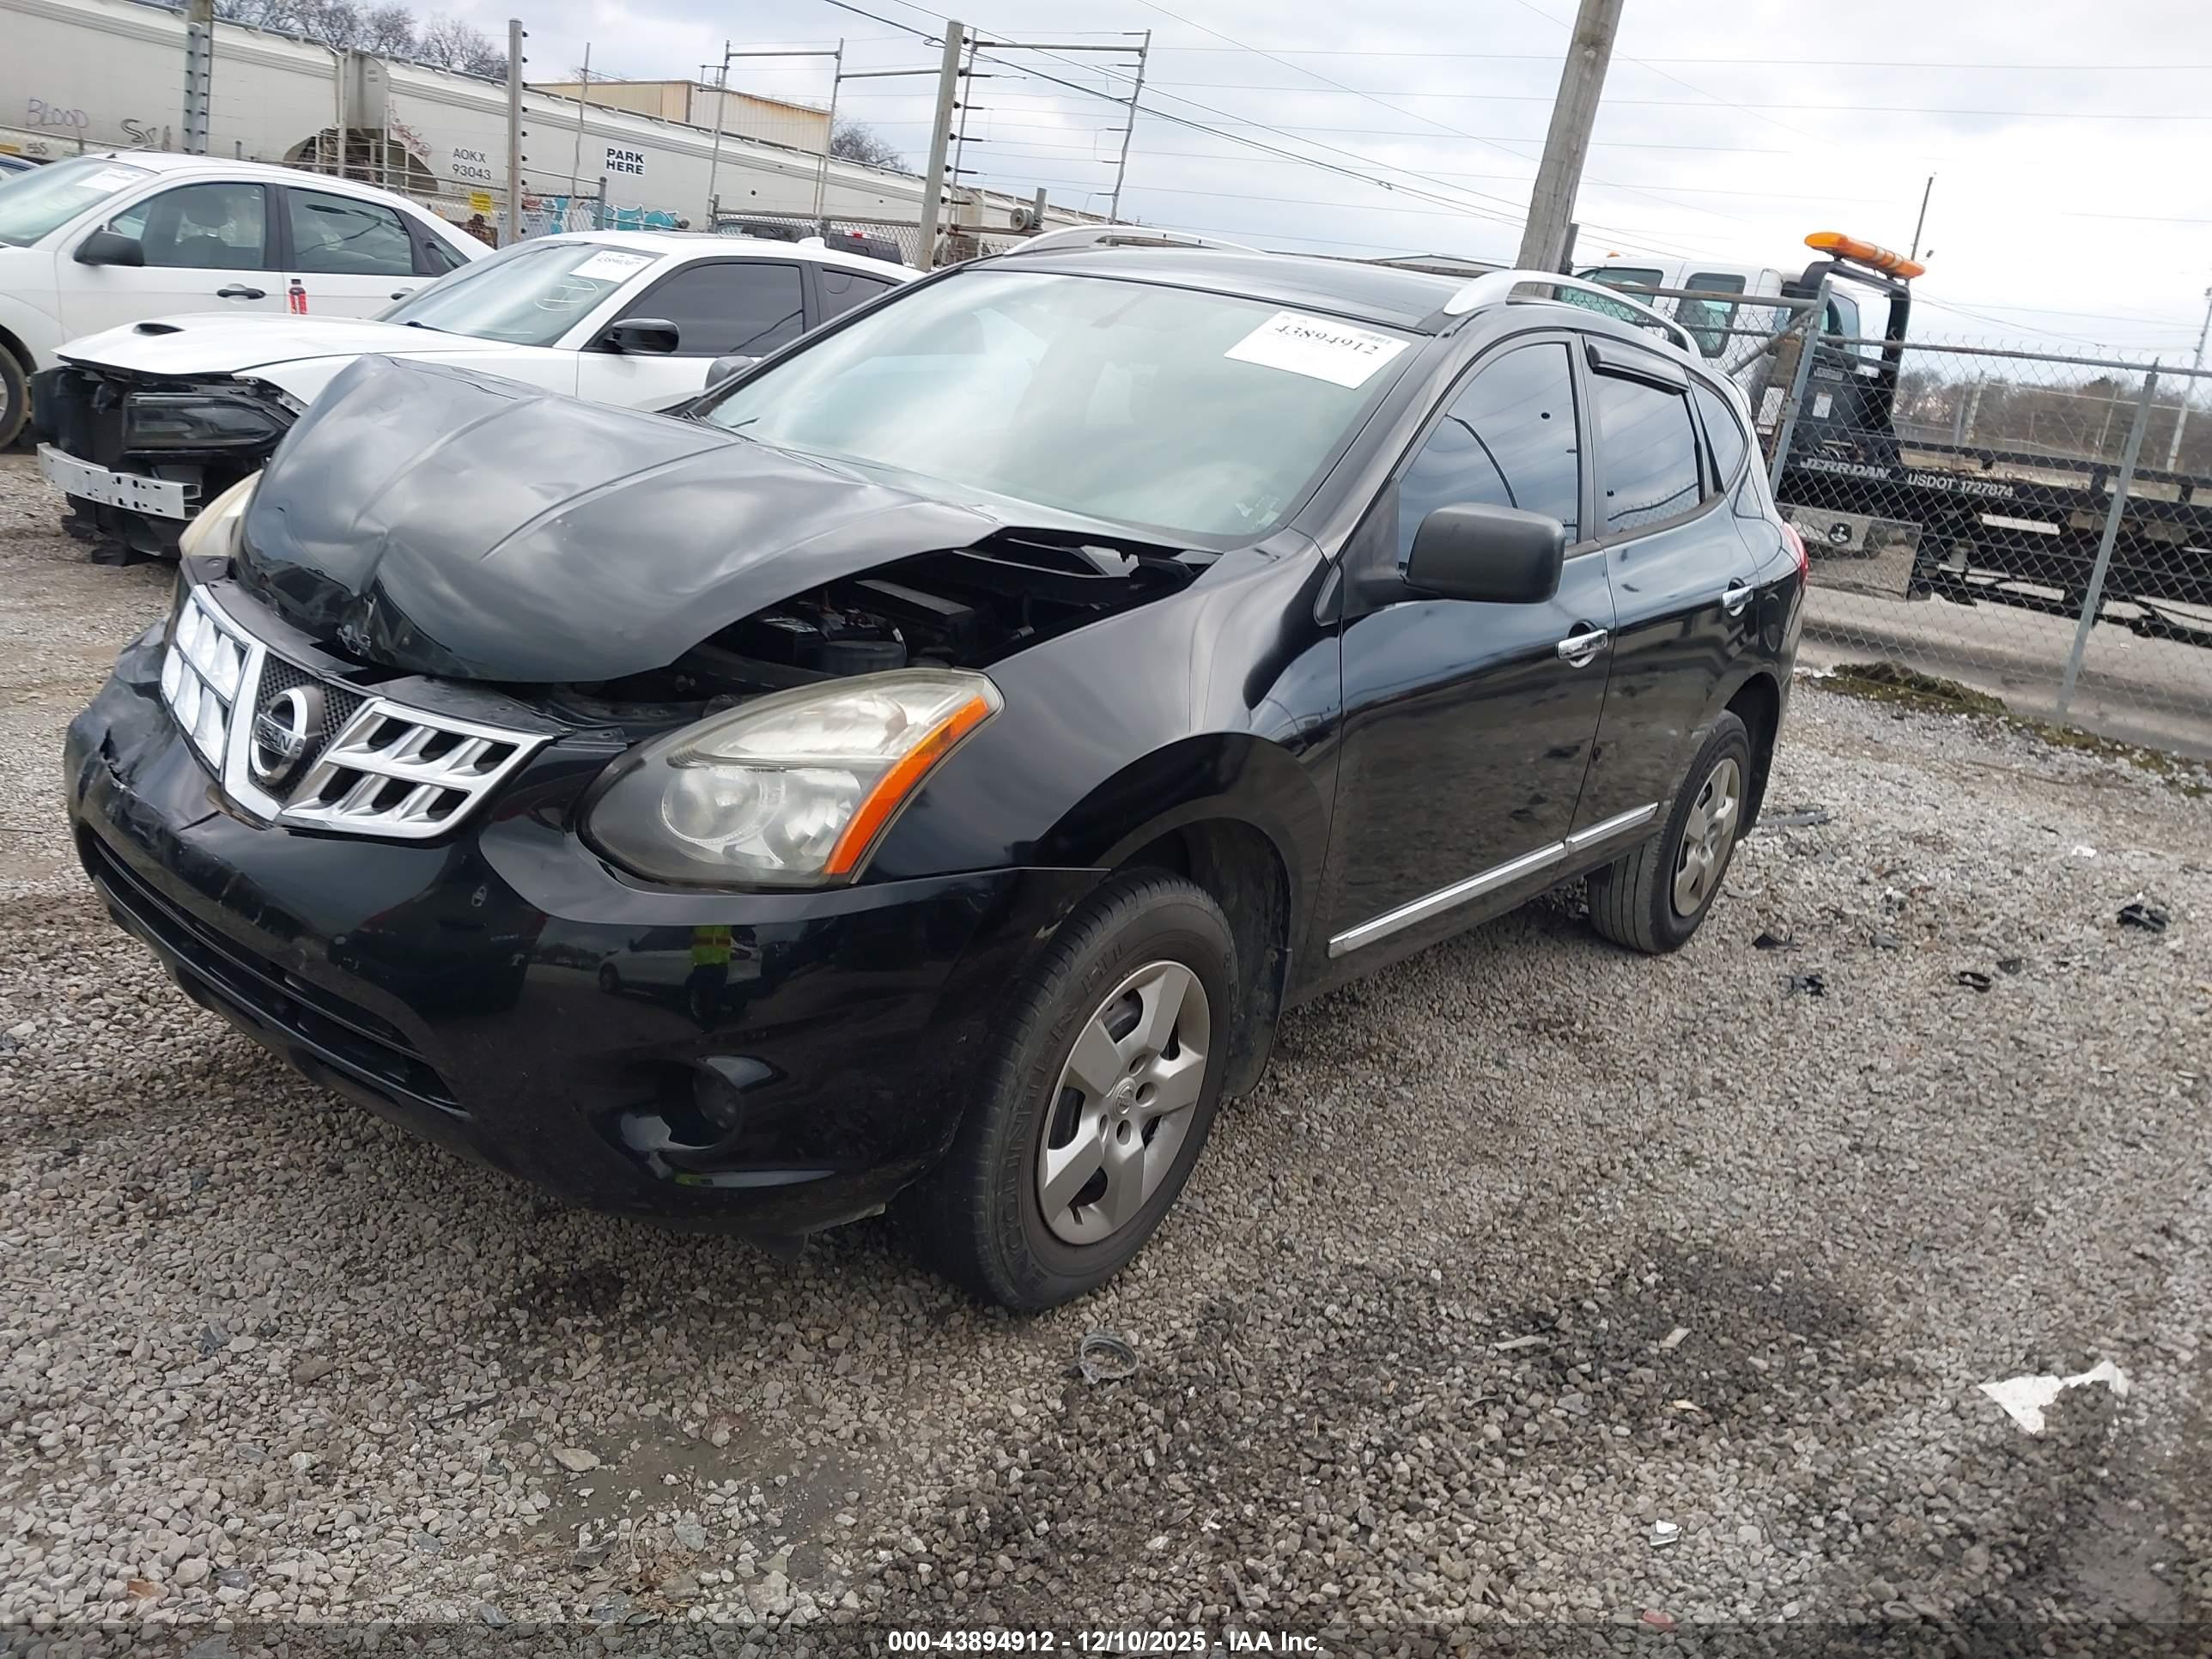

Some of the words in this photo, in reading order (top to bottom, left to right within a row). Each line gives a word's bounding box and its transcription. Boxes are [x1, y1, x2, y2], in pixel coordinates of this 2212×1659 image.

[453, 148, 487, 164] AOKX
[606, 148, 645, 164] PARK
[452, 163, 492, 180] 93043
[605, 159, 644, 175] HERE
[1906, 472, 1955, 491] USDOT
